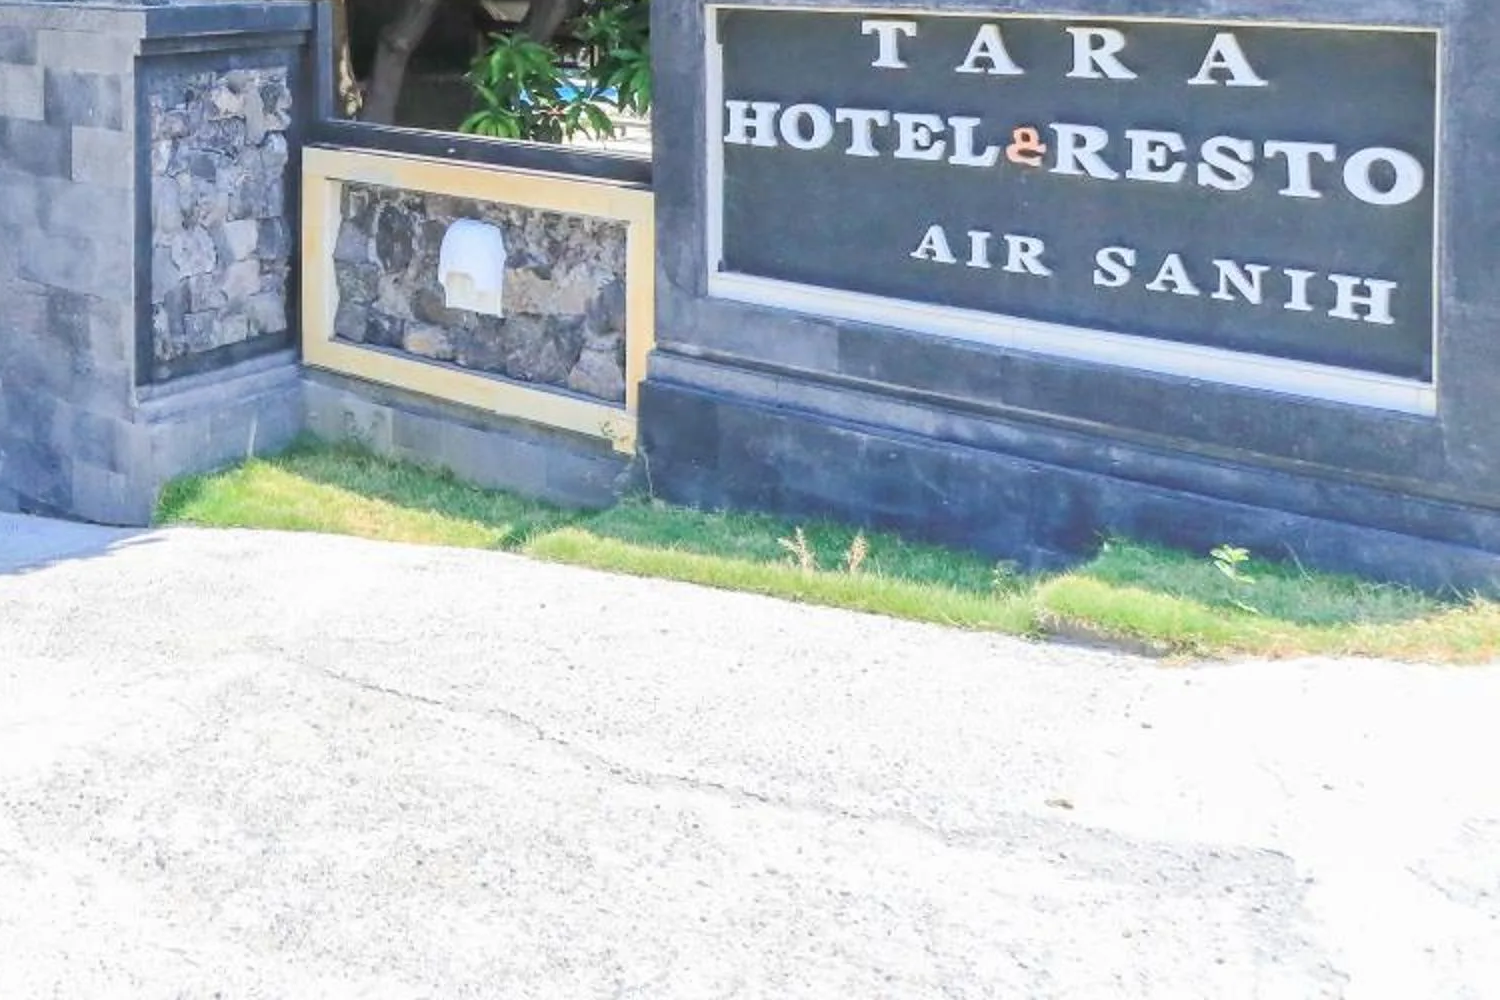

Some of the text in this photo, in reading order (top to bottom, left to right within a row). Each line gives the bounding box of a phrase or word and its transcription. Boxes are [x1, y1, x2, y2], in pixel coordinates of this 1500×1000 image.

[861, 19, 1269, 88] TARA
[910, 224, 1399, 326] AIR SANIH
